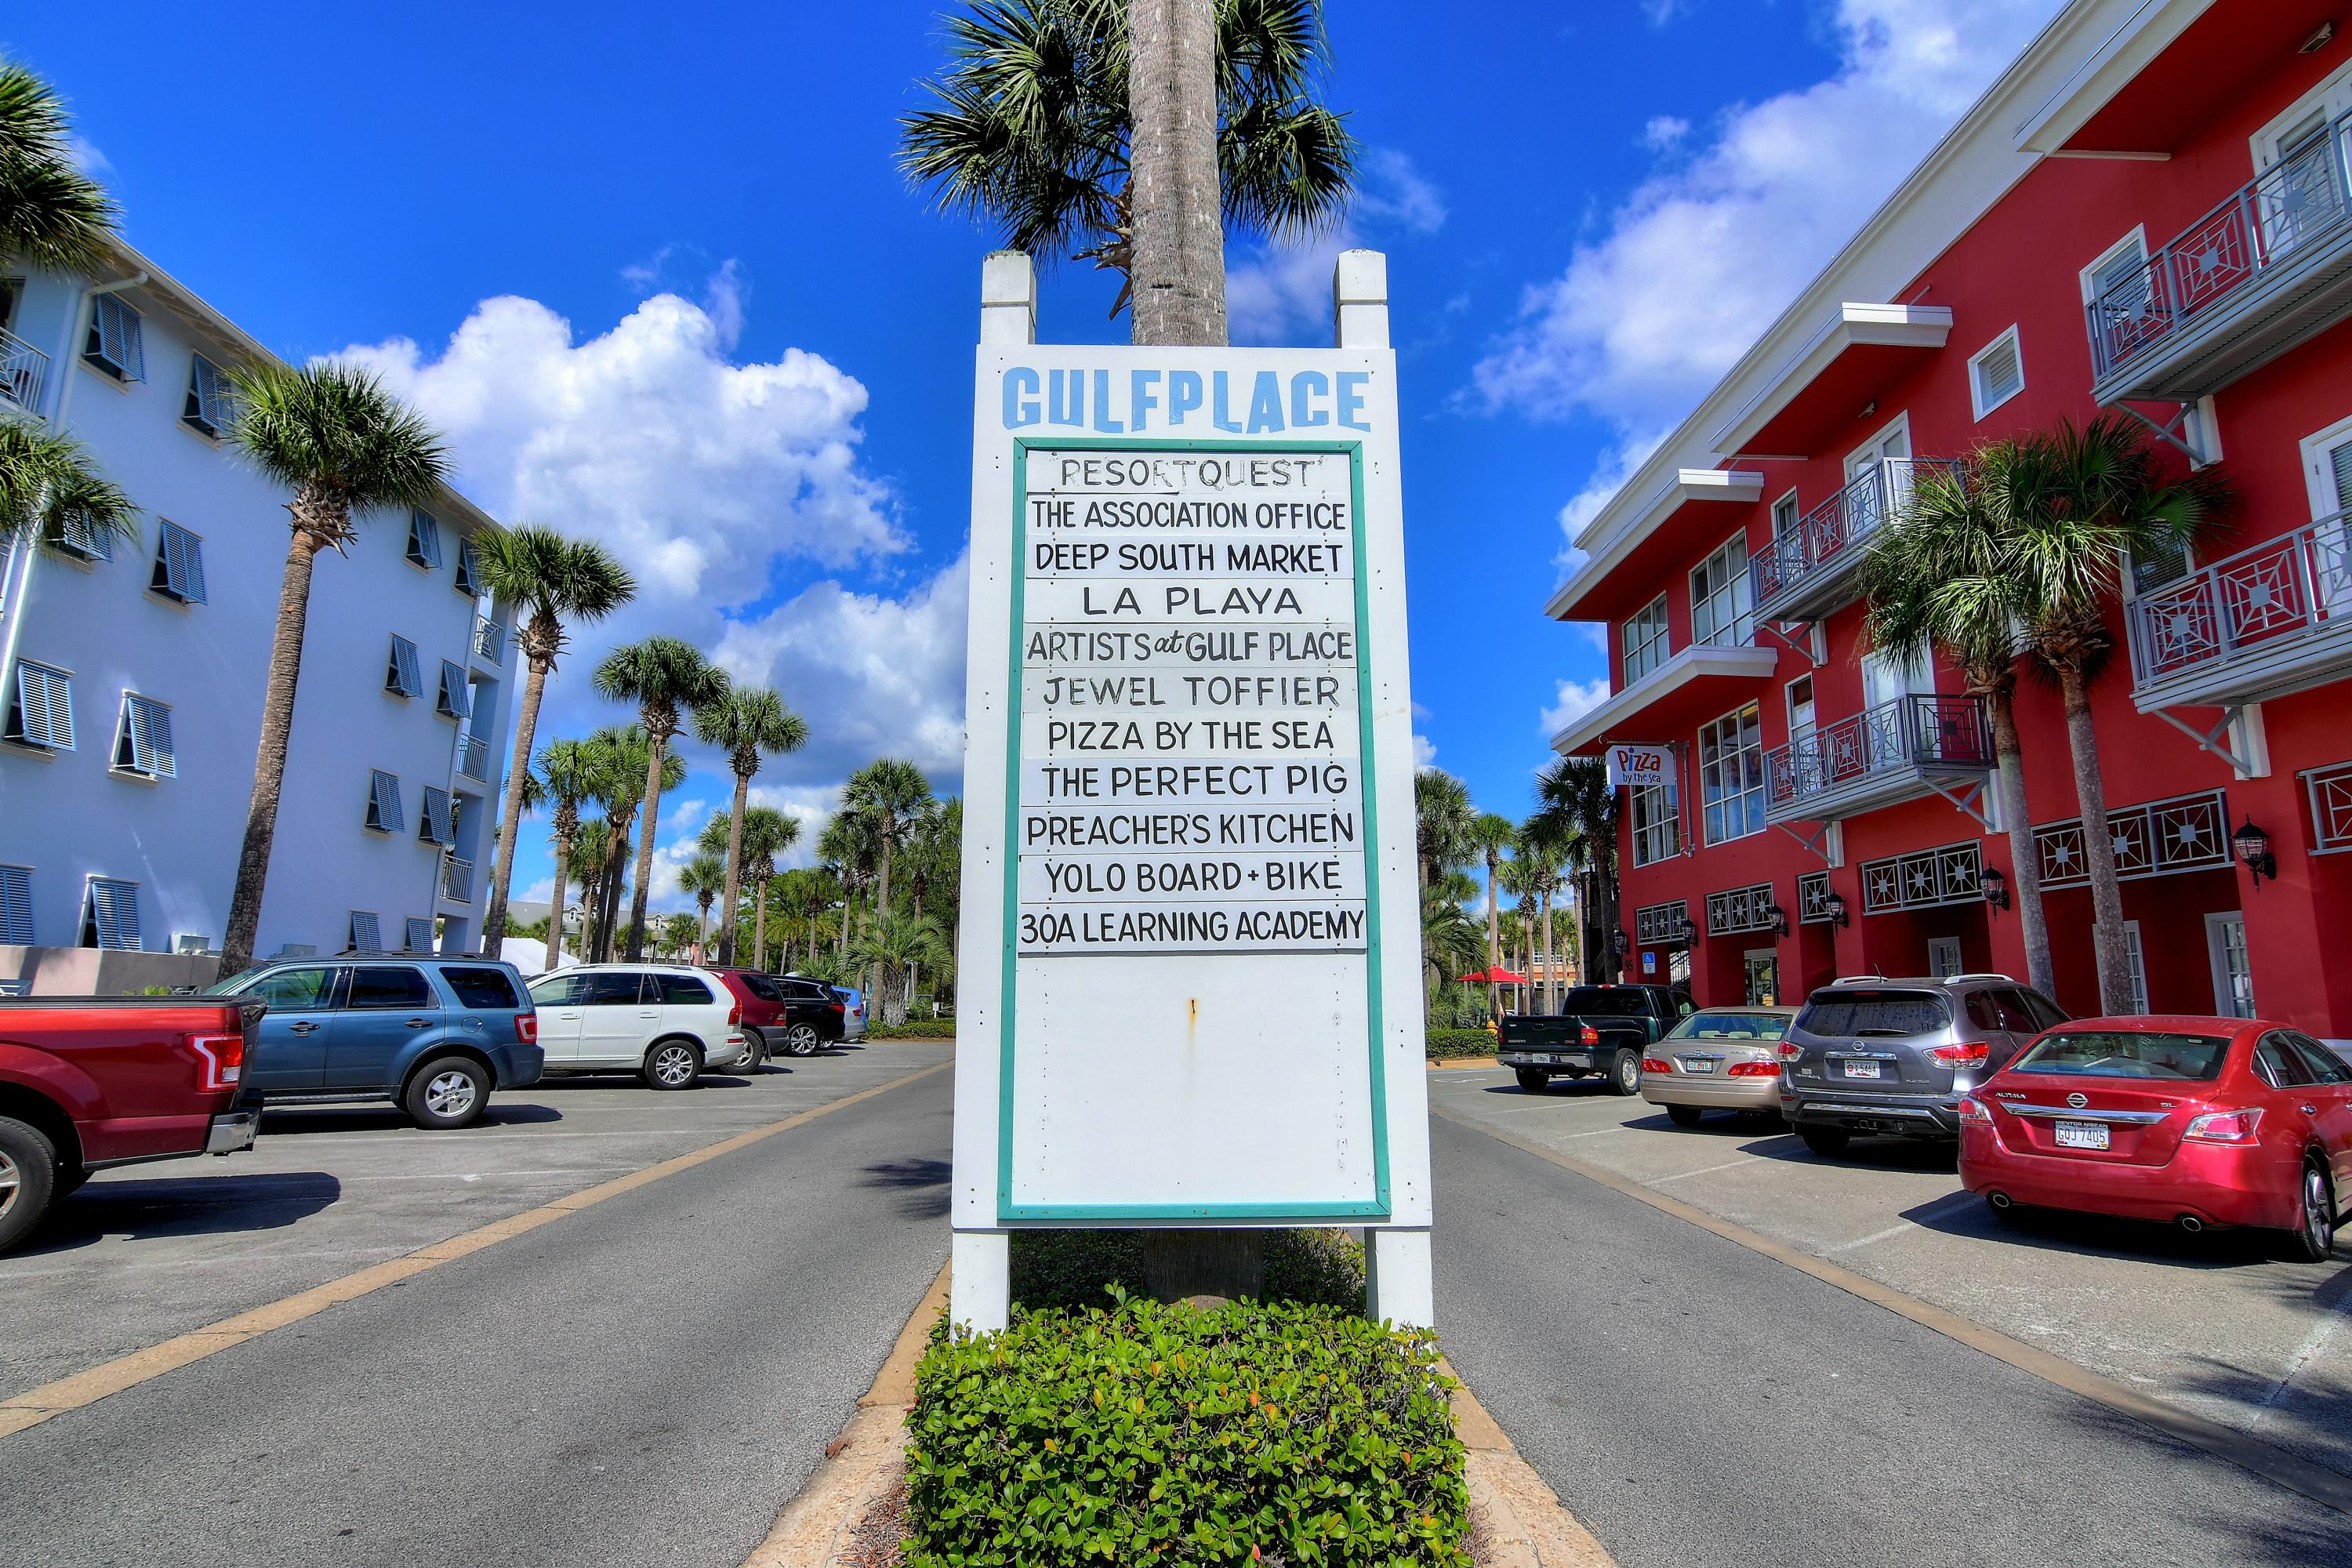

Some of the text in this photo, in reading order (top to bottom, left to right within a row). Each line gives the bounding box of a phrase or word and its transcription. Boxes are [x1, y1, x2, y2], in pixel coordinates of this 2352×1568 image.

[1032, 501, 1346, 530] THE ASSOCIATION OFFICE
[1036, 543, 1343, 574] DEEP SOUTH MARKET
[1083, 587, 1303, 615] LA PLAYA
[1027, 630, 1353, 662] ARTISTS at GULF PLACE
[1044, 677, 1340, 706] JEWEL TOFFIER
[1049, 720, 1334, 750] PIZZA BY THE SEA
[1617, 747, 1661, 771] Pizza
[1042, 765, 1348, 797] THE PERFECT PIG
[1622, 773, 1632, 784] by
[1633, 772, 1647, 782] the
[1027, 813, 1354, 845] PREACHER'S KITCHEN
[1044, 863, 1126, 893] YOLO
[1138, 862, 1242, 892] BOARD
[1266, 862, 1343, 891] BIKE
[1021, 910, 1364, 944] 30A LEARNING ACADEMY
[1860, 1064, 1876, 1073] 5464
[2080, 1129, 2105, 1143] 7405
